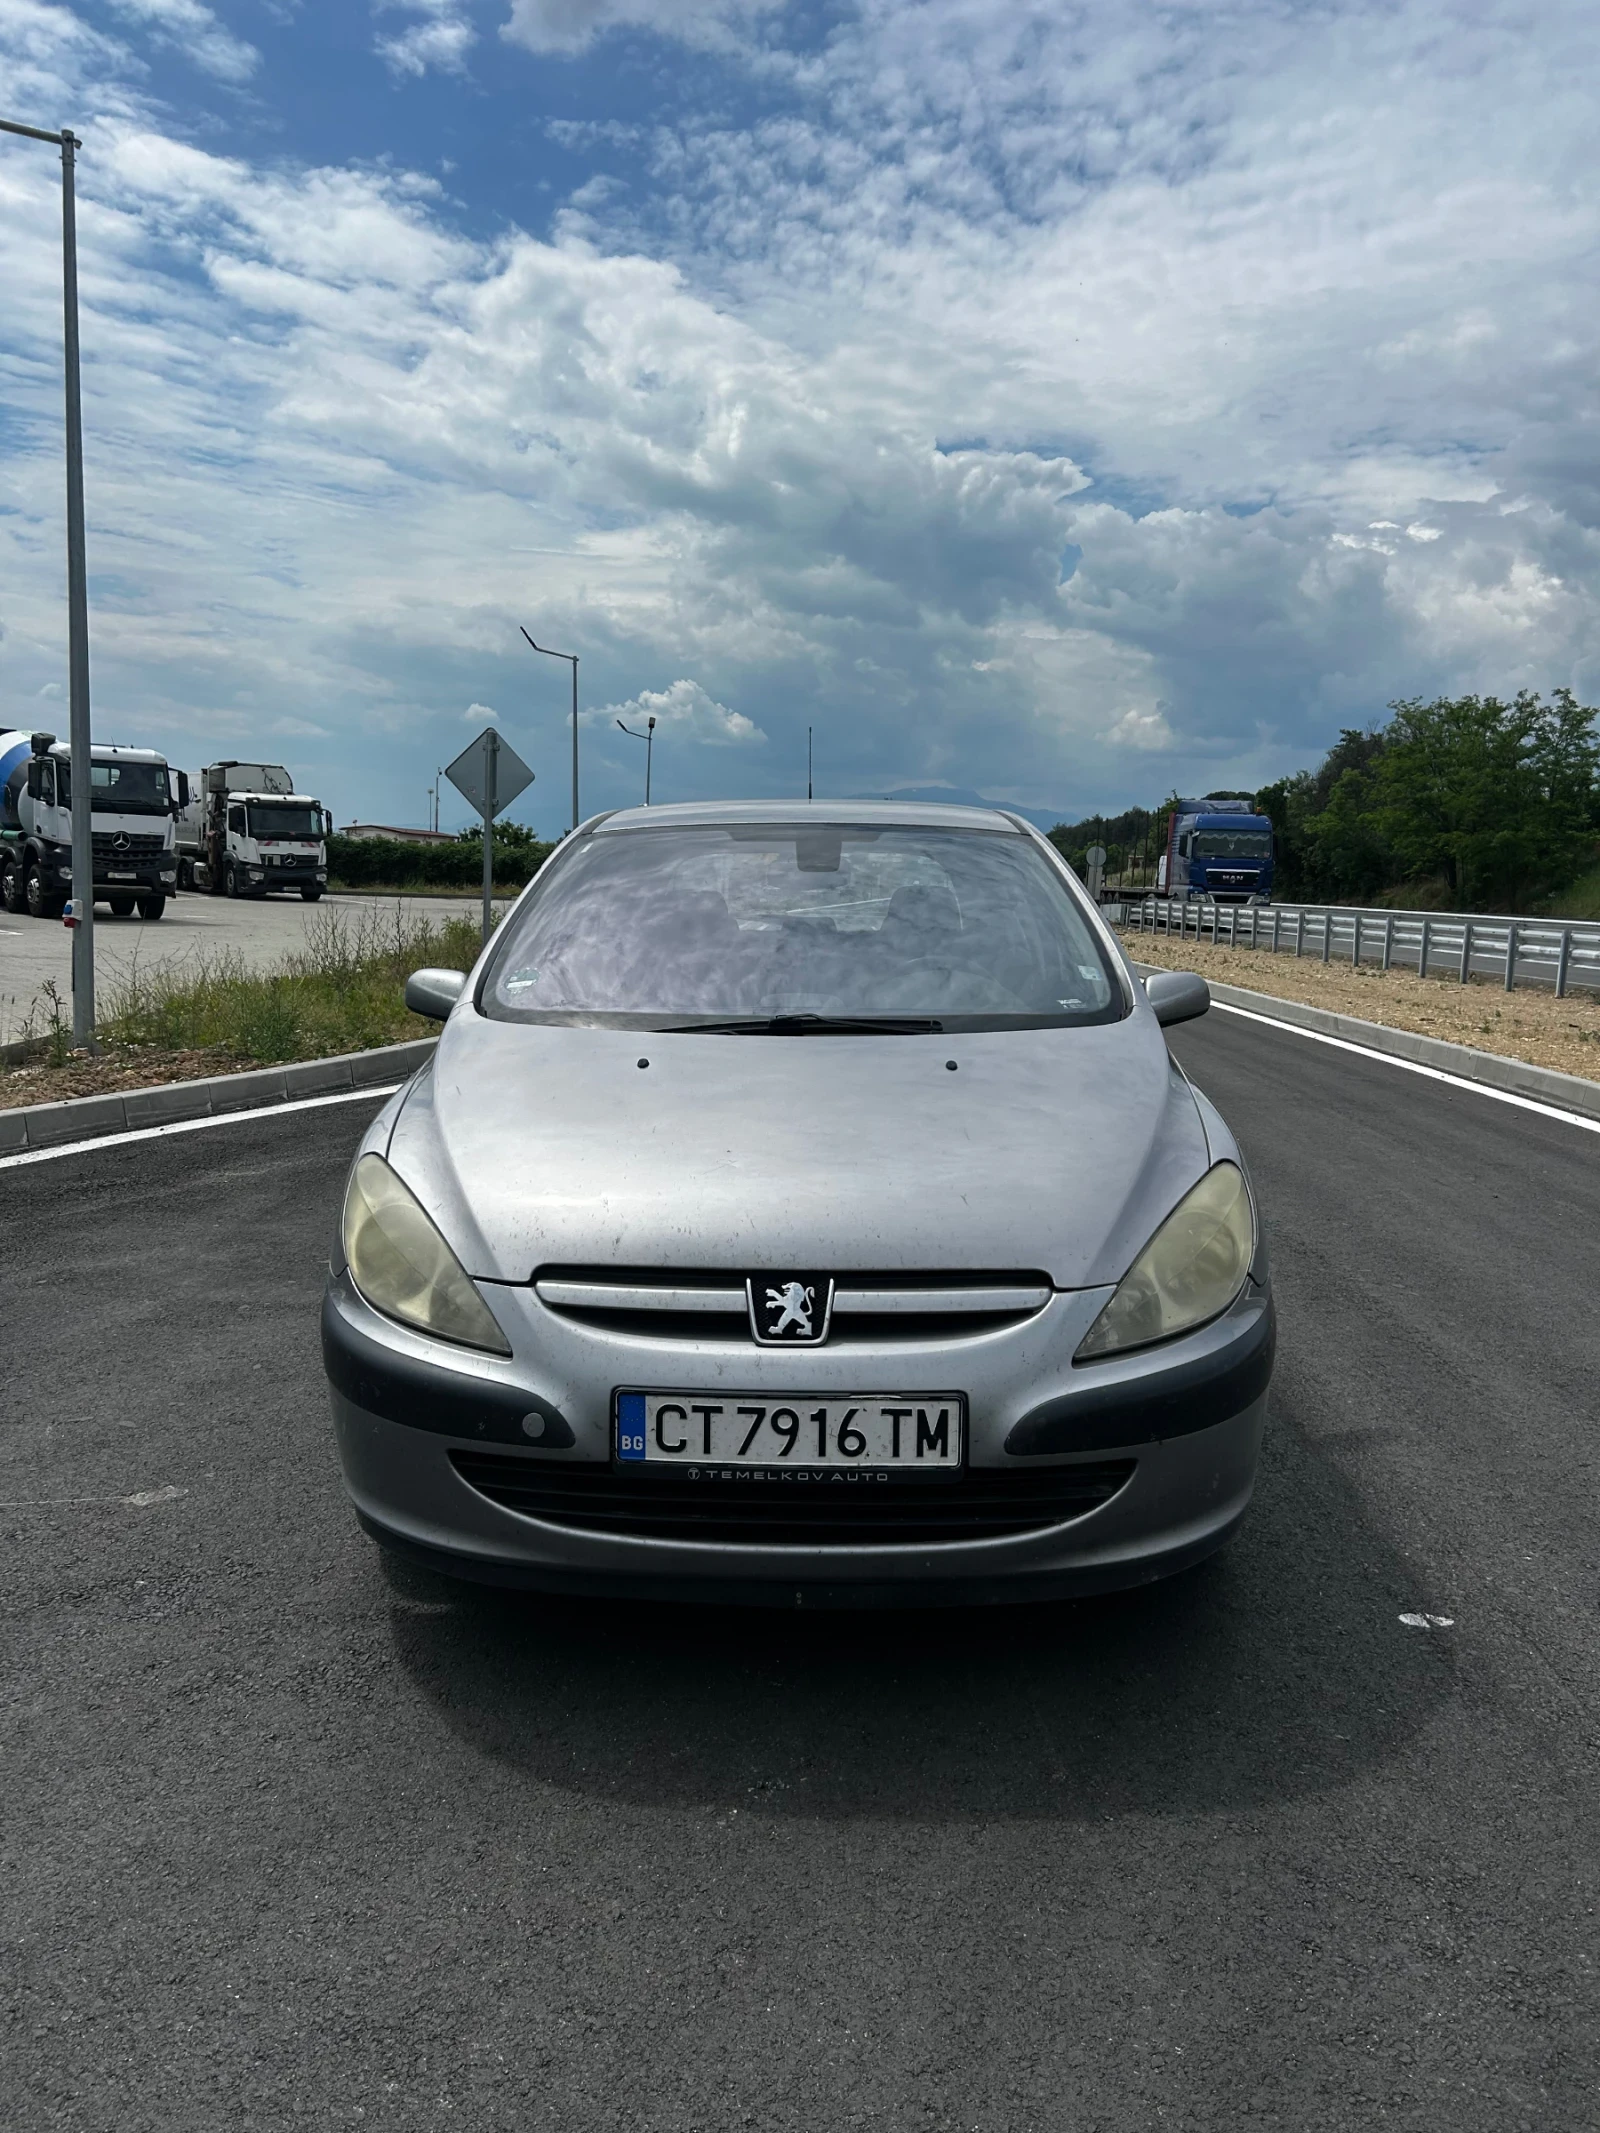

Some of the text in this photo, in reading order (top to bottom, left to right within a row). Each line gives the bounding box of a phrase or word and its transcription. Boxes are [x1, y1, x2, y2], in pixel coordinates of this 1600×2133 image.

[655, 1404, 949, 1458] CT 7916 TM
[621, 1435, 643, 1451] BG
[705, 1470, 888, 1482] TEMELKOV AUTO
